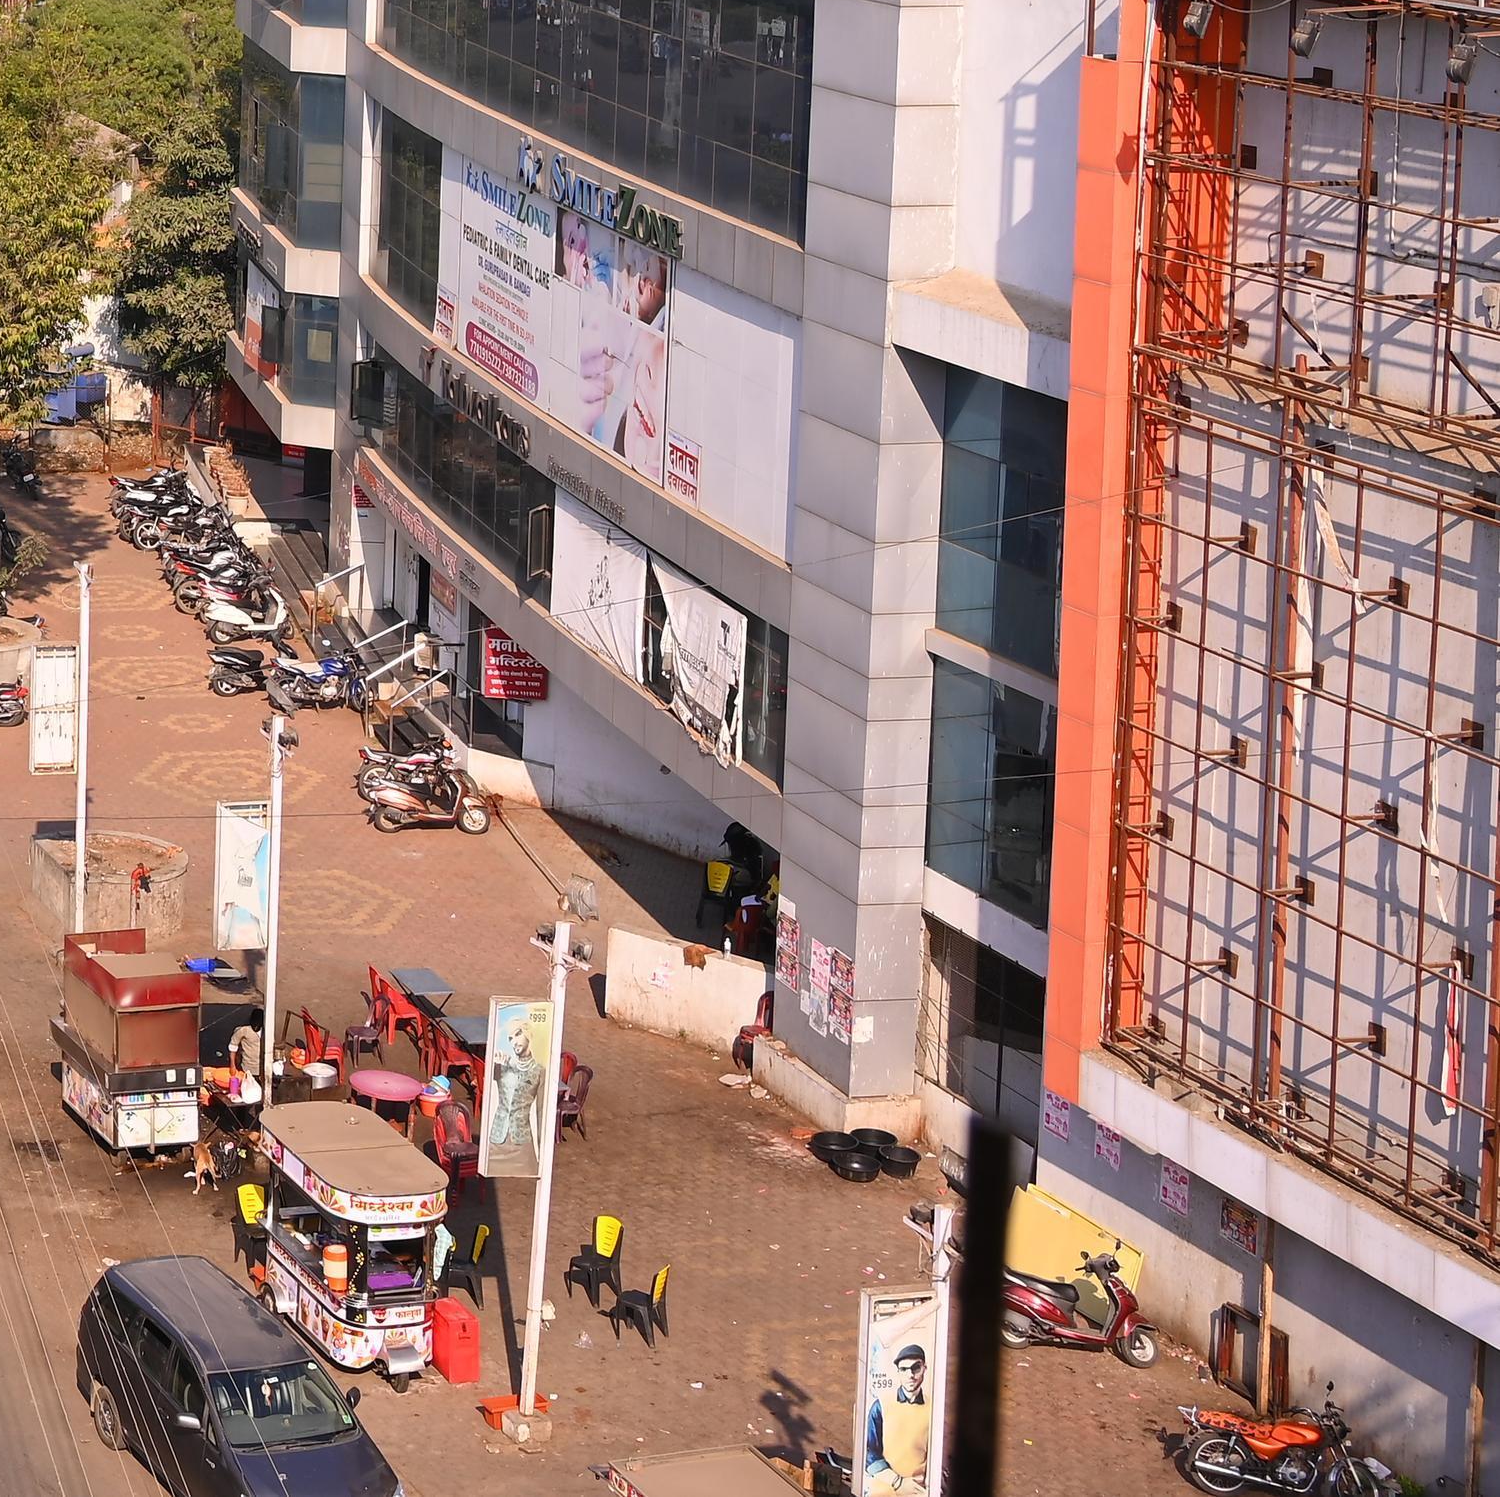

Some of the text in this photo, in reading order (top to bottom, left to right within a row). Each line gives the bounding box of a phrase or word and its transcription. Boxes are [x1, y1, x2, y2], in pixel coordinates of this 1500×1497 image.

[463, 223, 488, 252] PEDIATRIC
[494, 241, 512, 266] FAMILY
[513, 253, 533, 281] DENTAL
[534, 266, 550, 290] CARE
[473, 327, 482, 341] FOR
